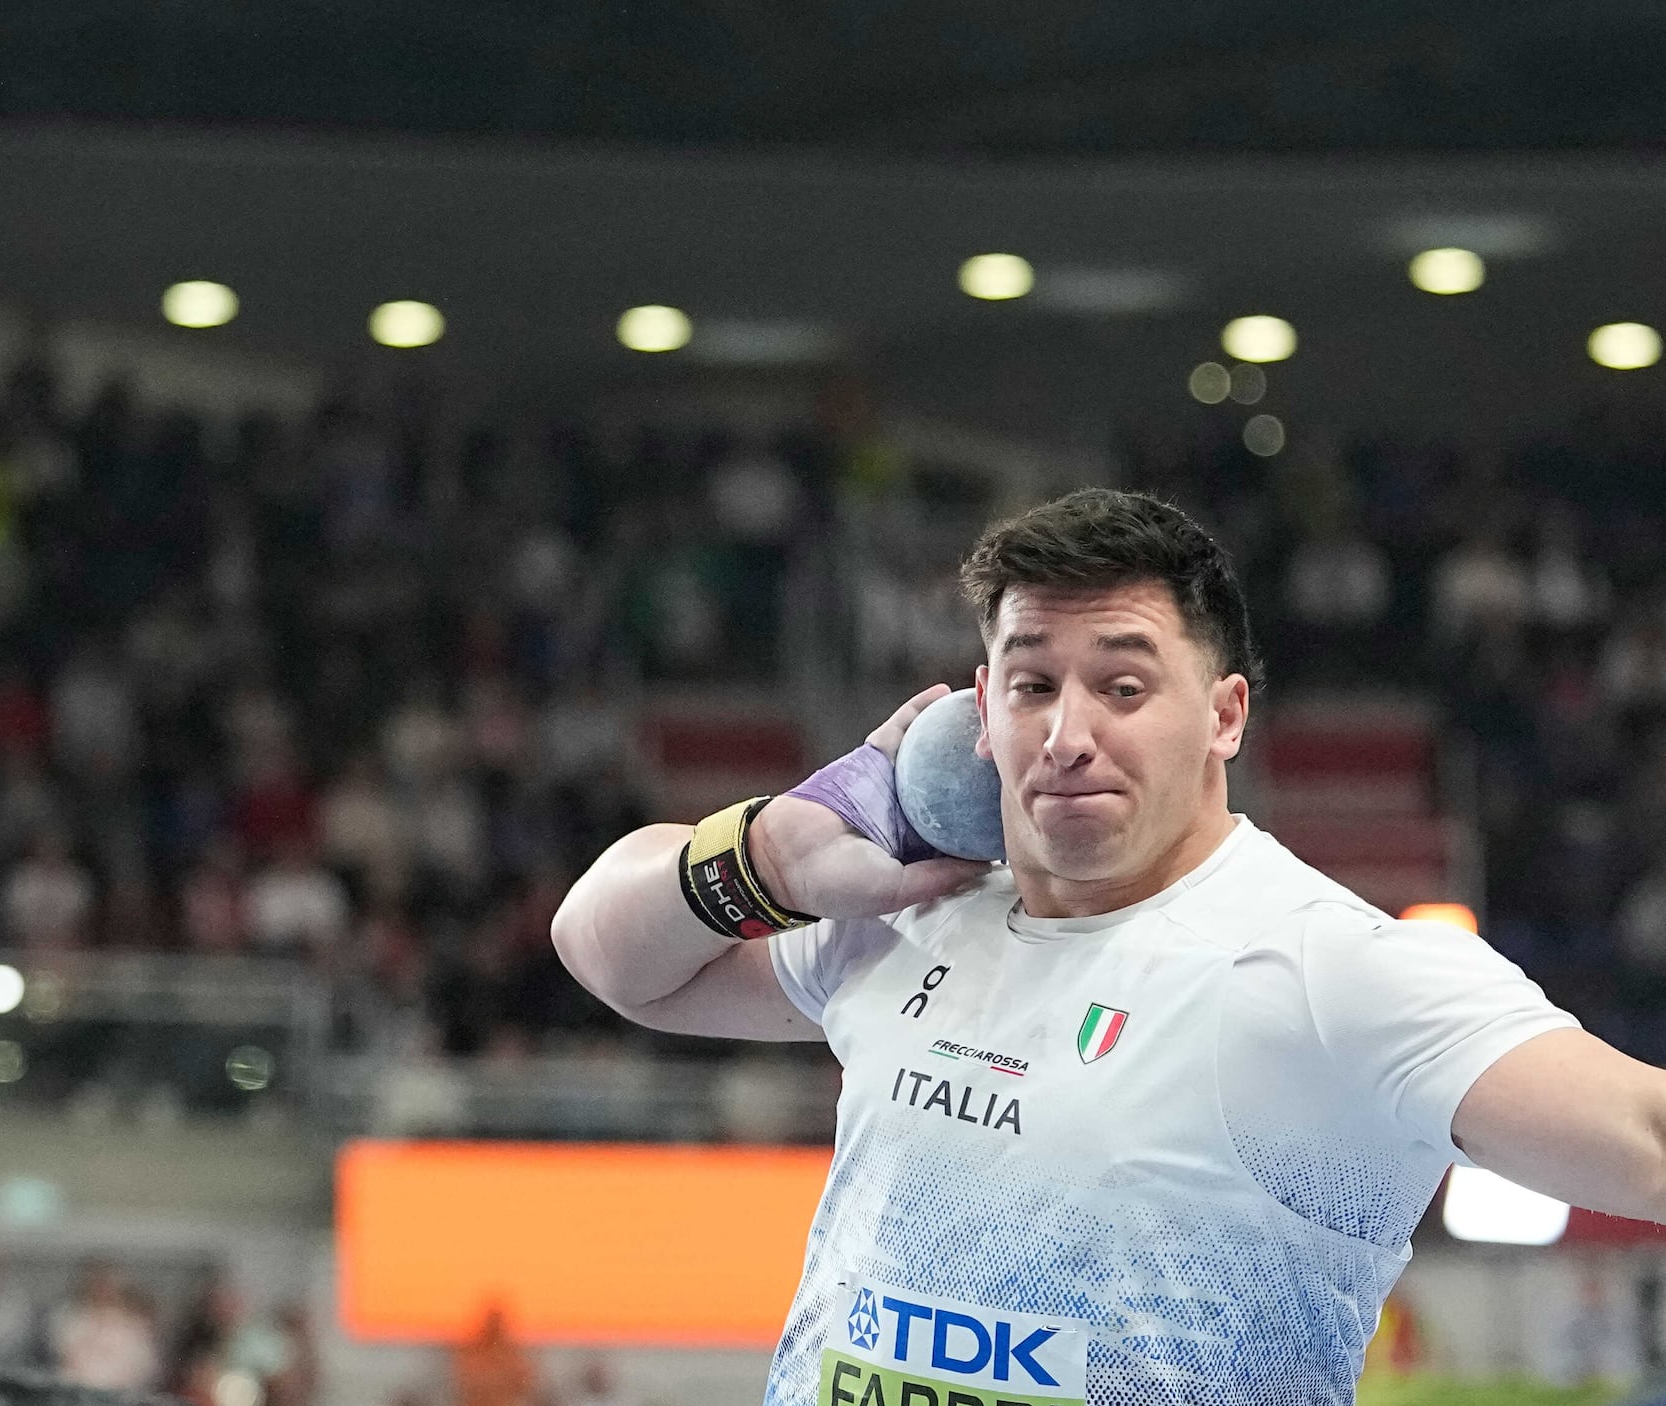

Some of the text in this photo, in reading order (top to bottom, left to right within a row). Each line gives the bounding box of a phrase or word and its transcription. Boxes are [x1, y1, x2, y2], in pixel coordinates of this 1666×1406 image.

[932, 1039, 1030, 1072] FRECCIAROSSA
[891, 1068, 1021, 1136] ITALIA
[883, 1295, 1061, 1387] TDK
